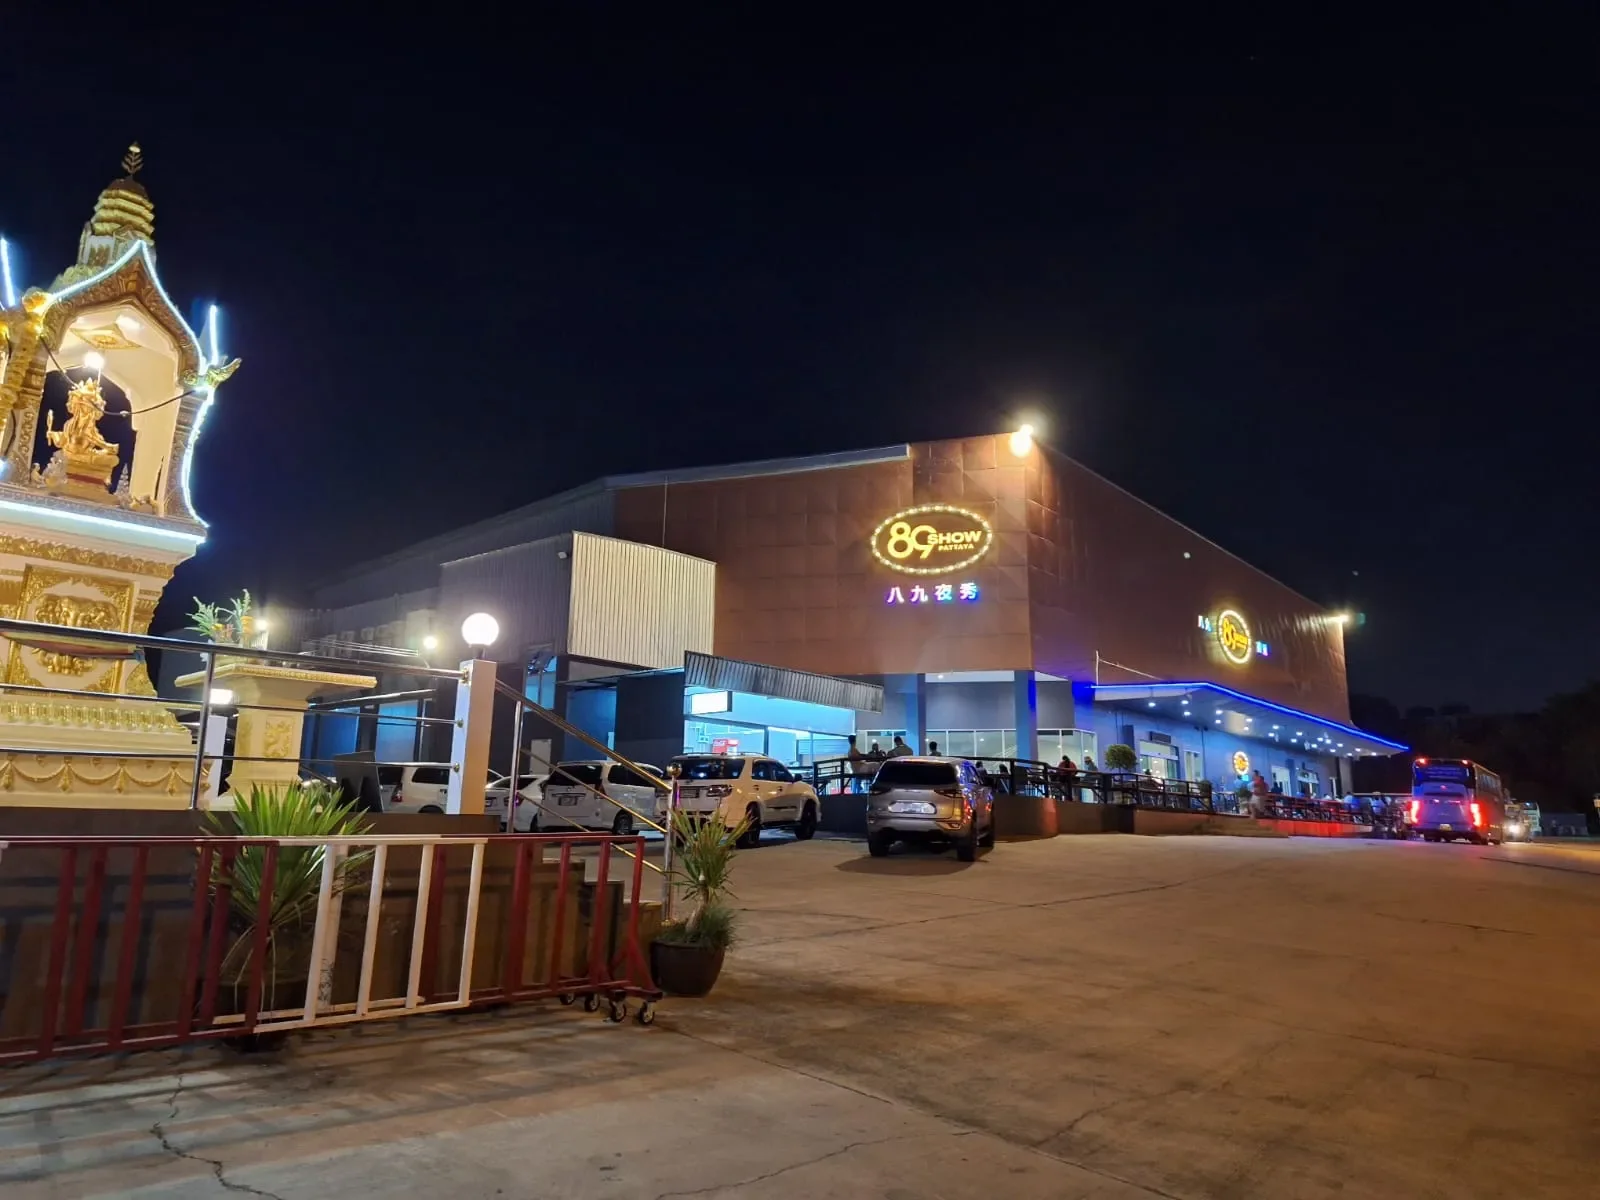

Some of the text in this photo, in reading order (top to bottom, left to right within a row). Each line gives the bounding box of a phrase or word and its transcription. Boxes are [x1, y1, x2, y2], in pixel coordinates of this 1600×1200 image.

[887, 521, 982, 559] 89 SHOW
[938, 543, 974, 551] PATTAYA
[887, 582, 977, 603] 八九夜秀
